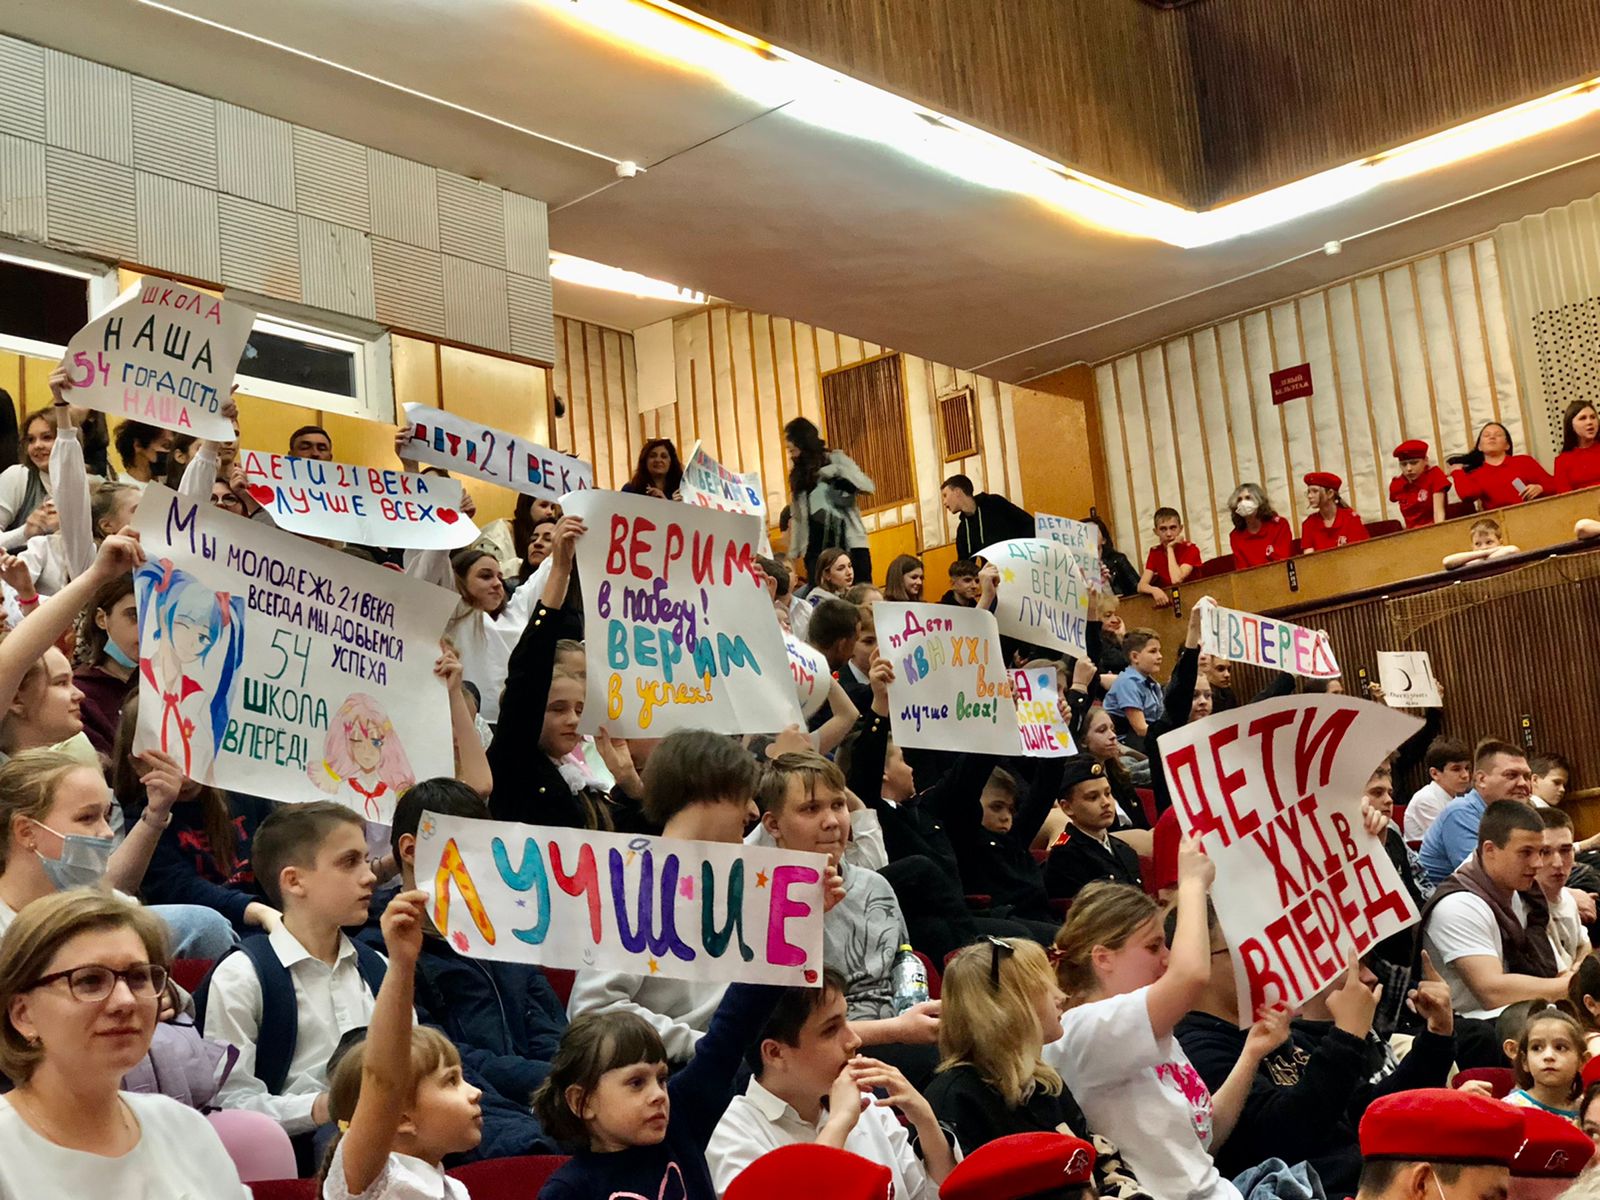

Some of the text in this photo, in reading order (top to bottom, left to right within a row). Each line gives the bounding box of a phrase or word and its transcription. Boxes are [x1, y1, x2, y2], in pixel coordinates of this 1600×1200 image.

[141, 286, 221, 326] ШКОЛА
[103, 314, 213, 375] НАША
[73, 351, 219, 414] 54 ГОРДОСТЬ
[123, 388, 192, 428] НАША
[245, 451, 429, 496] ДЕТИ 21 ВЕКА
[408, 422, 477, 465] ДЕТИ
[480, 430, 516, 482] 21
[275, 485, 436, 524] ЛУЧШЕ ВСЕХ
[605, 512, 762, 589] ВЕРИМ
[1007, 541, 1067, 577] ДЕТИ
[227, 543, 336, 607] МОЛОДЕЖЬ
[337, 586, 359, 613] 21
[360, 591, 396, 631] ВЕКА
[1031, 568, 1079, 610] ВЕКА
[247, 584, 404, 663] ВСЕГДА МЫ ДОБЬЕМСЯ
[607, 618, 763, 684] ВЕРИМ
[1018, 595, 1086, 650] ЛУЧШИЕ
[263, 629, 312, 689] 54
[330, 643, 388, 687] УСПЕХА
[902, 633, 946, 686] КВН
[243, 675, 328, 732] ШКОЛА
[900, 691, 998, 733] лучше всех!
[221, 717, 308, 772] ВПЕРЁД!
[1165, 706, 1360, 849] ДЕТИ
[1252, 793, 1343, 910] XXI
[433, 836, 820, 967] ЛУЧШИЕ
[1238, 854, 1412, 1023] ВПЕРЕД
